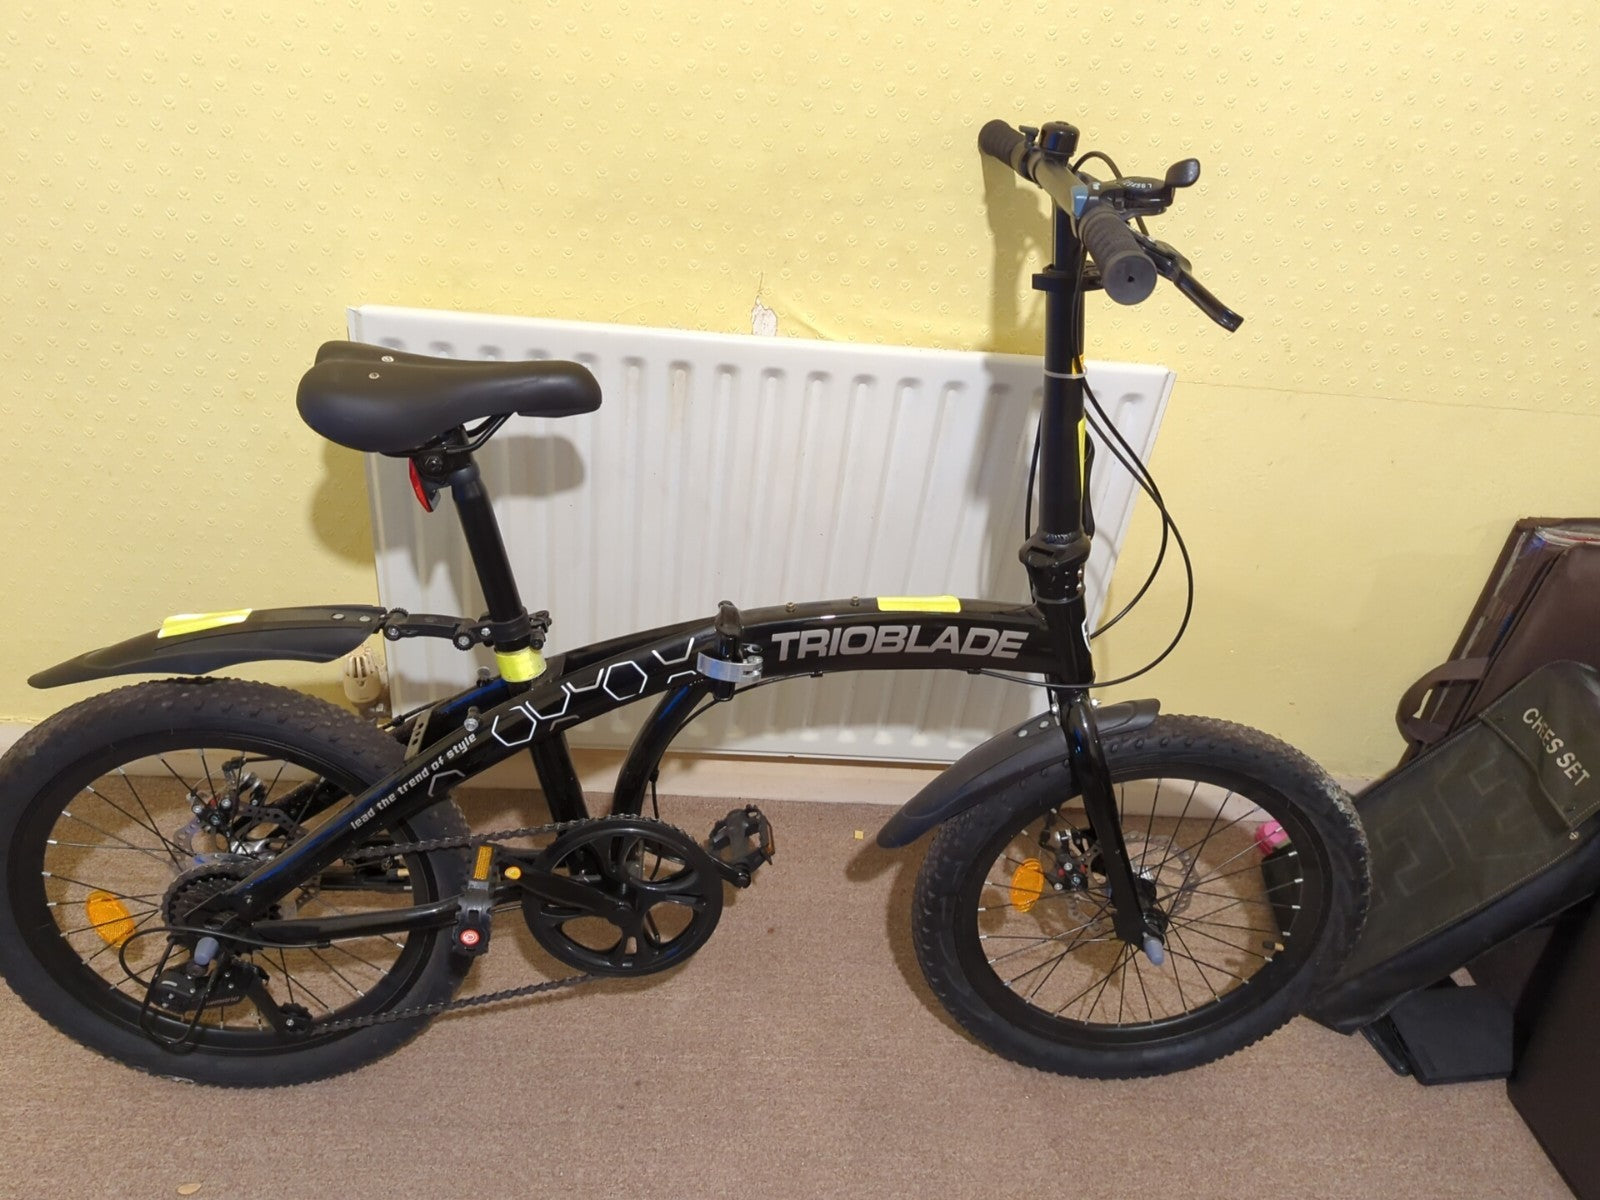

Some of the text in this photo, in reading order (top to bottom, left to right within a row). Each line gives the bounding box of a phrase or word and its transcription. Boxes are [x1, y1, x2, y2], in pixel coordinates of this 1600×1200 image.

[771, 625, 1029, 661] TRIOBLADE
[350, 733, 477, 830] lead the trend of style
[1556, 752, 1591, 786] SET
